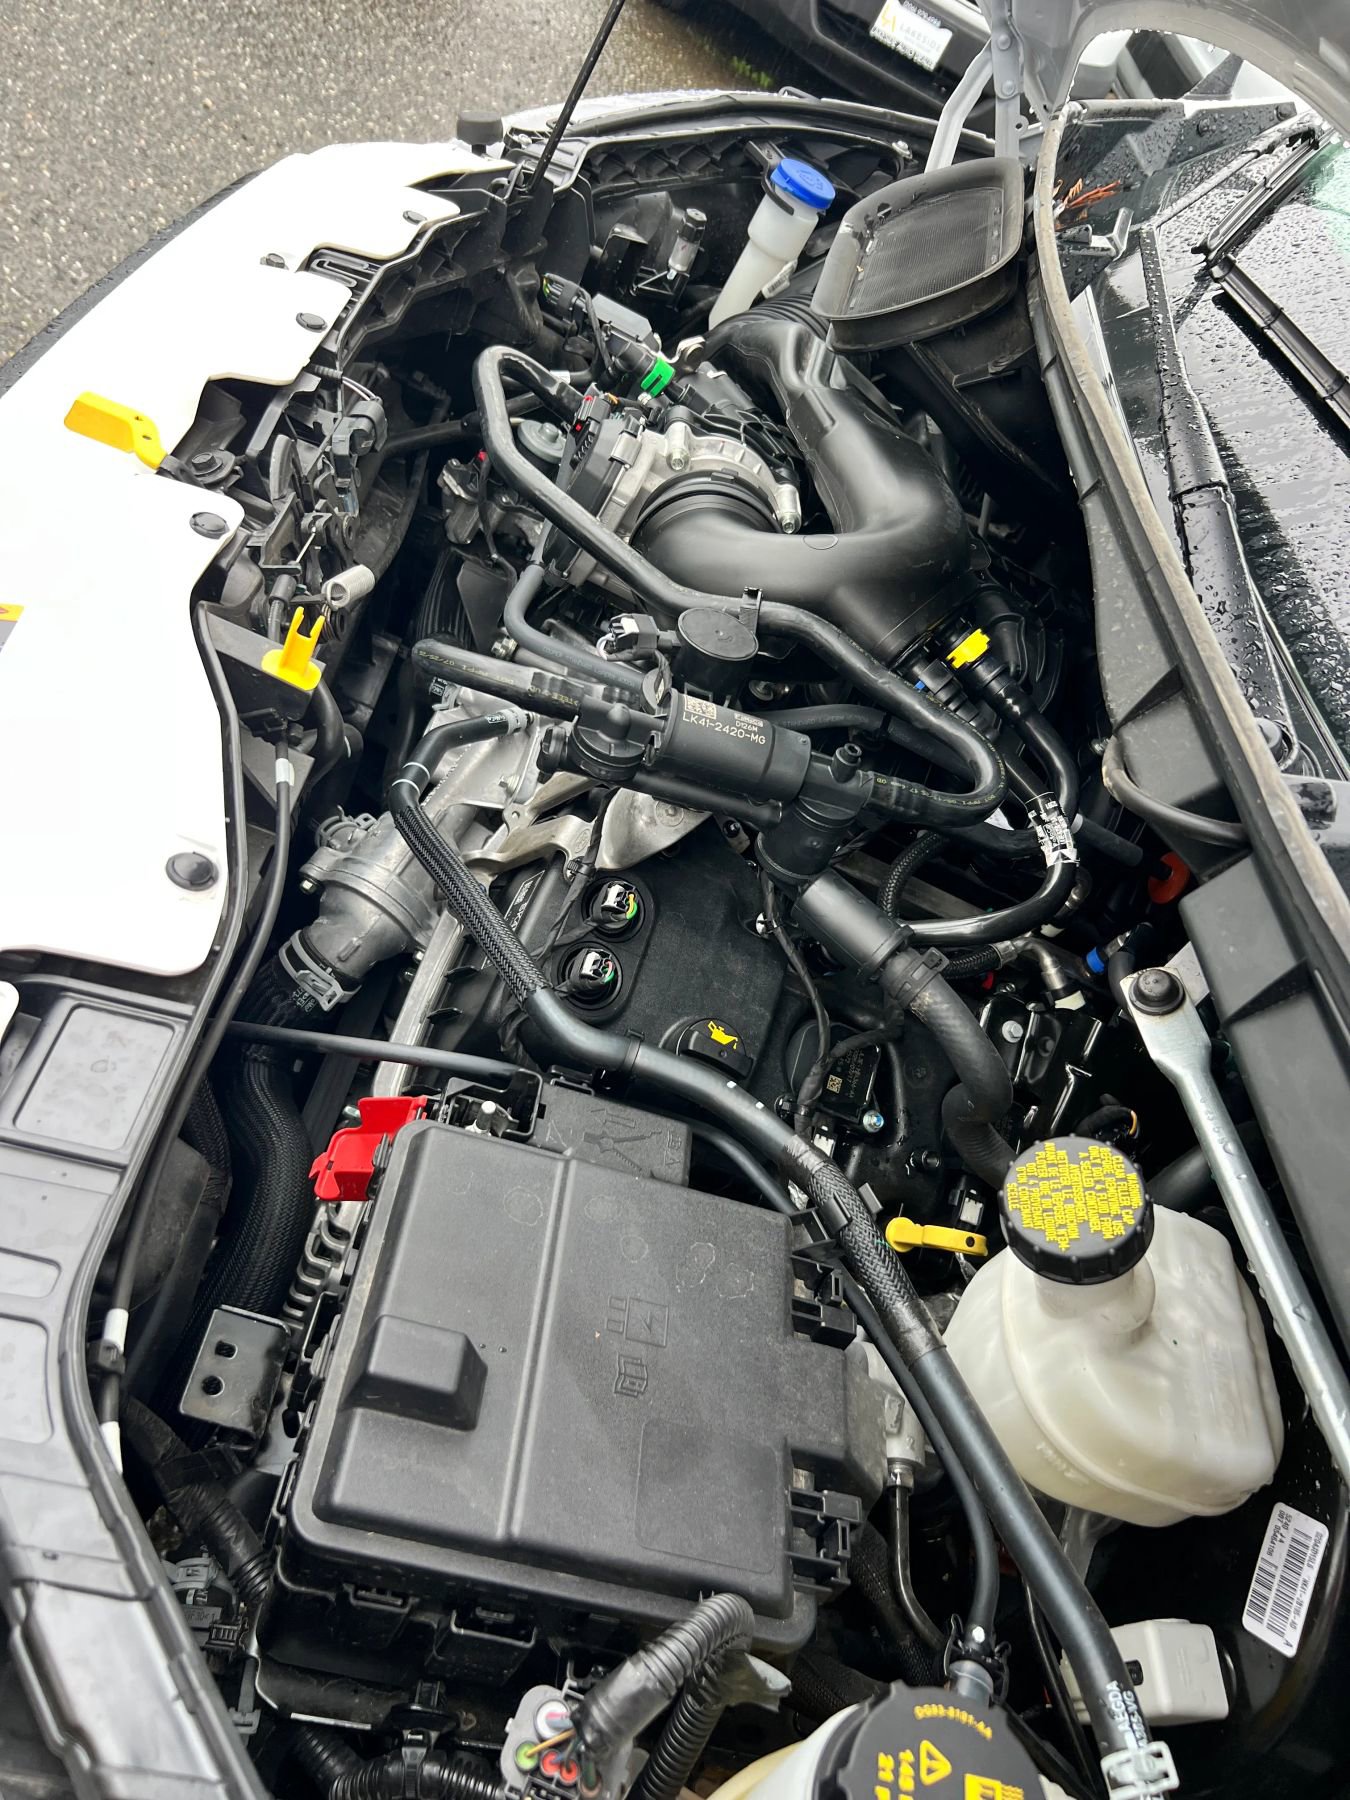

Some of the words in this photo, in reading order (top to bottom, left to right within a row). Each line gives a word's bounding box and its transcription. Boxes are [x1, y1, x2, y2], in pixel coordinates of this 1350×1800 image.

[682, 712, 766, 745] LK41-2420-MG
[1036, 1151, 1048, 1178] PLOYER
[1045, 1143, 1057, 1166] AVANT
[1088, 1146, 1101, 1165] ONLY
[1025, 1162, 1037, 1178] DOT
[1047, 1167, 1059, 1177] DE
[1055, 1150, 1069, 1187] NETTOYER
[1080, 1161, 1094, 1188] SEALED
[1091, 1166, 1104, 1182] DOT
[1112, 1156, 1126, 1179] CLEAN
[1039, 1181, 1051, 1197] QUE
[1049, 1178, 1061, 1191] LE
[1061, 1189, 1073, 1200] LE
[1099, 1148, 1115, 1175] BEFORE
[1111, 1219, 1124, 1236] USE
[1116, 1181, 1131, 1207] FILLER
[1018, 1187, 1033, 1228] CONTENANT
[1029, 1188, 1045, 1230] PROVENANT
[1041, 1198, 1053, 1210] DU
[1096, 1192, 1110, 1215] FLUID
[1043, 1212, 1057, 1242] LIQUIDE
[1064, 1203, 1079, 1239] BOUCHON
[1100, 1217, 1115, 1240] FROM
[1121, 1210, 1134, 1225] CAP
